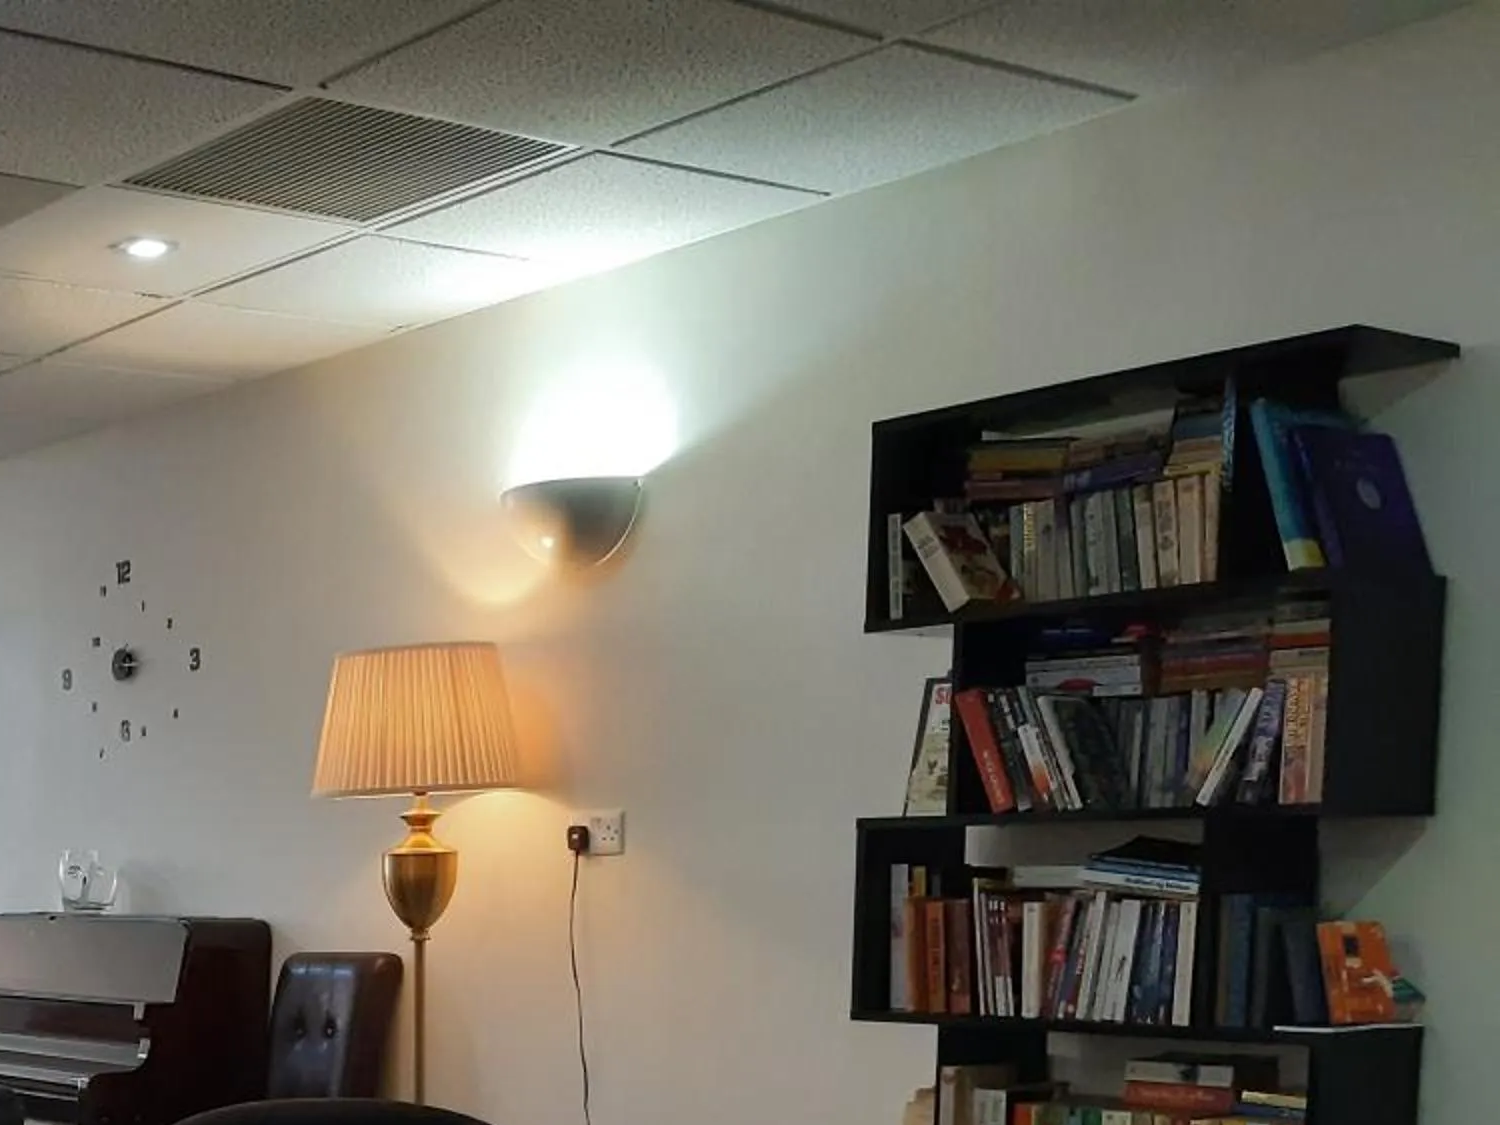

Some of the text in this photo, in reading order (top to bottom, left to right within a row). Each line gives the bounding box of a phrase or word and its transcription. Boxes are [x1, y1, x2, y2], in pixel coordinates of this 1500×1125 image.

[115, 560, 131, 585] 12
[189, 647, 201, 671] 3
[62, 668, 73, 691] 9
